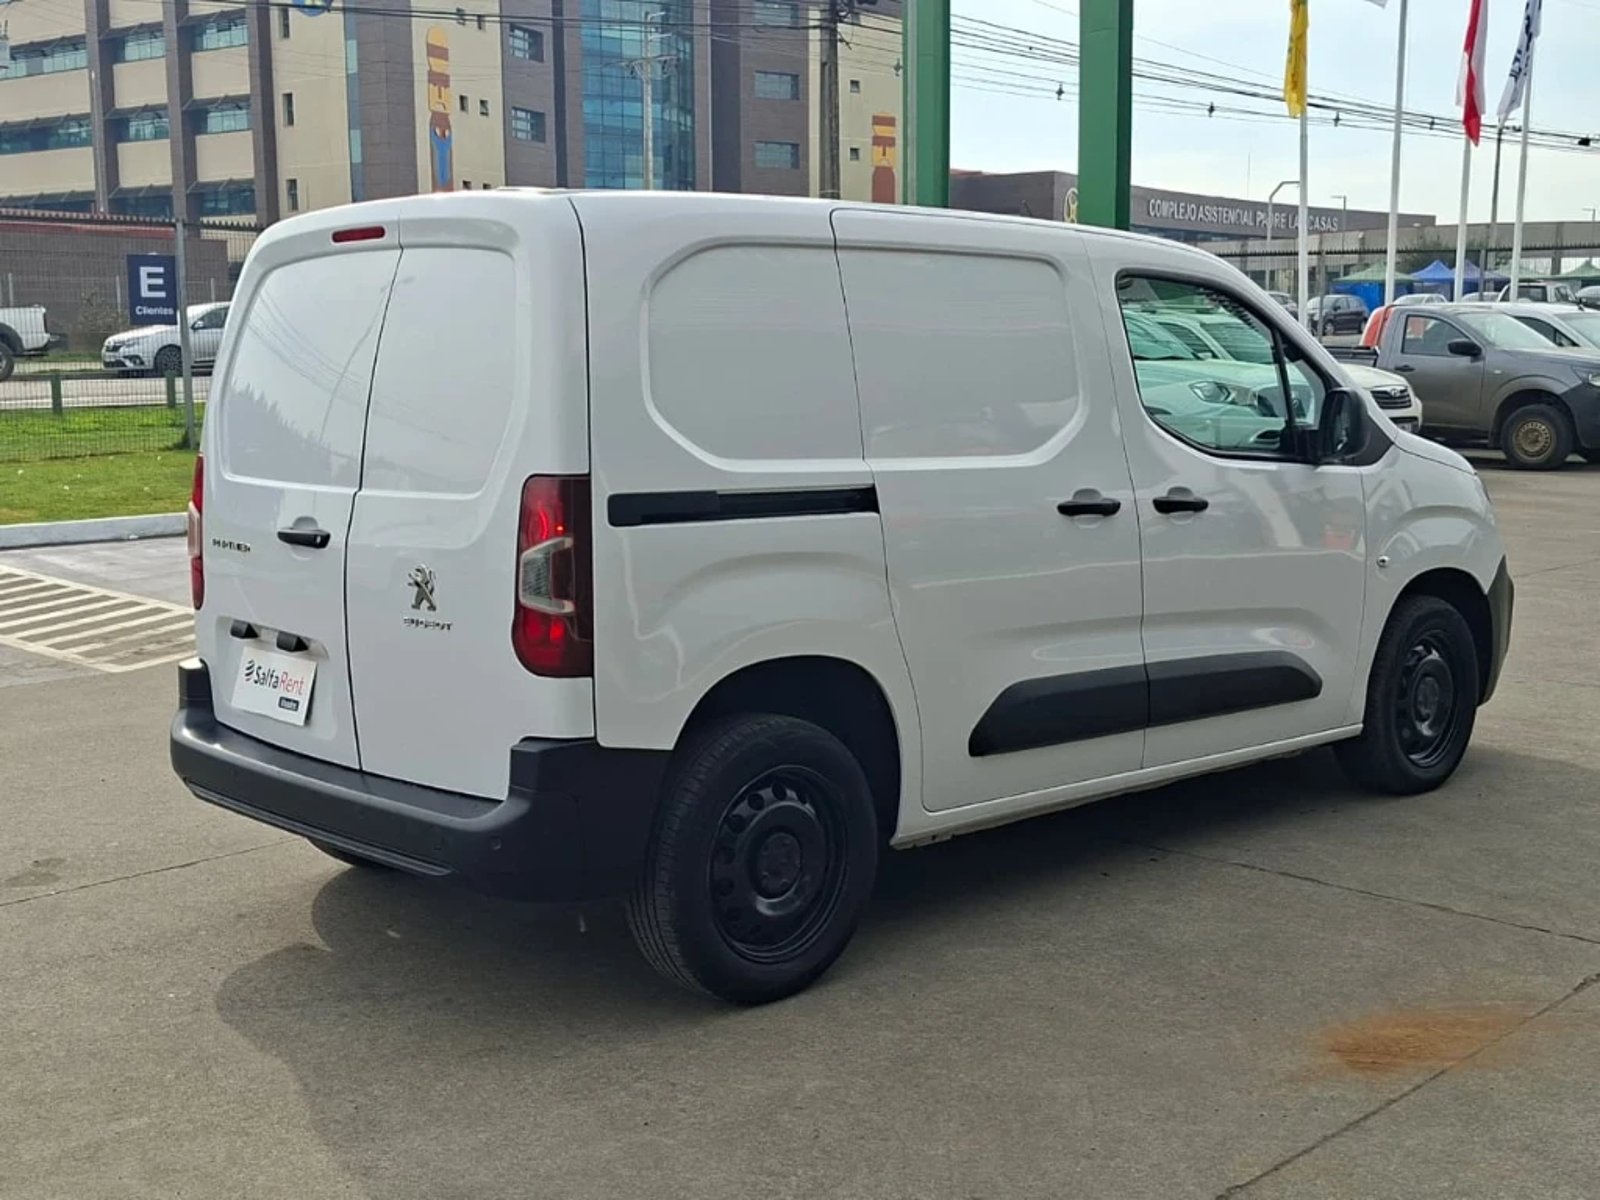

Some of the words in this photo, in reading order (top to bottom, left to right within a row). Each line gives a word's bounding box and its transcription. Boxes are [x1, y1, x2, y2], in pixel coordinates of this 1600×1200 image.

[1149, 199, 1197, 220] COMPLEJO
[1198, 204, 1254, 226] ASISTENCIAL
[1256, 210, 1287, 230] PARE
[1308, 215, 1338, 232] CASAS
[139, 266, 166, 298] E
[135, 305, 174, 315] Clientes
